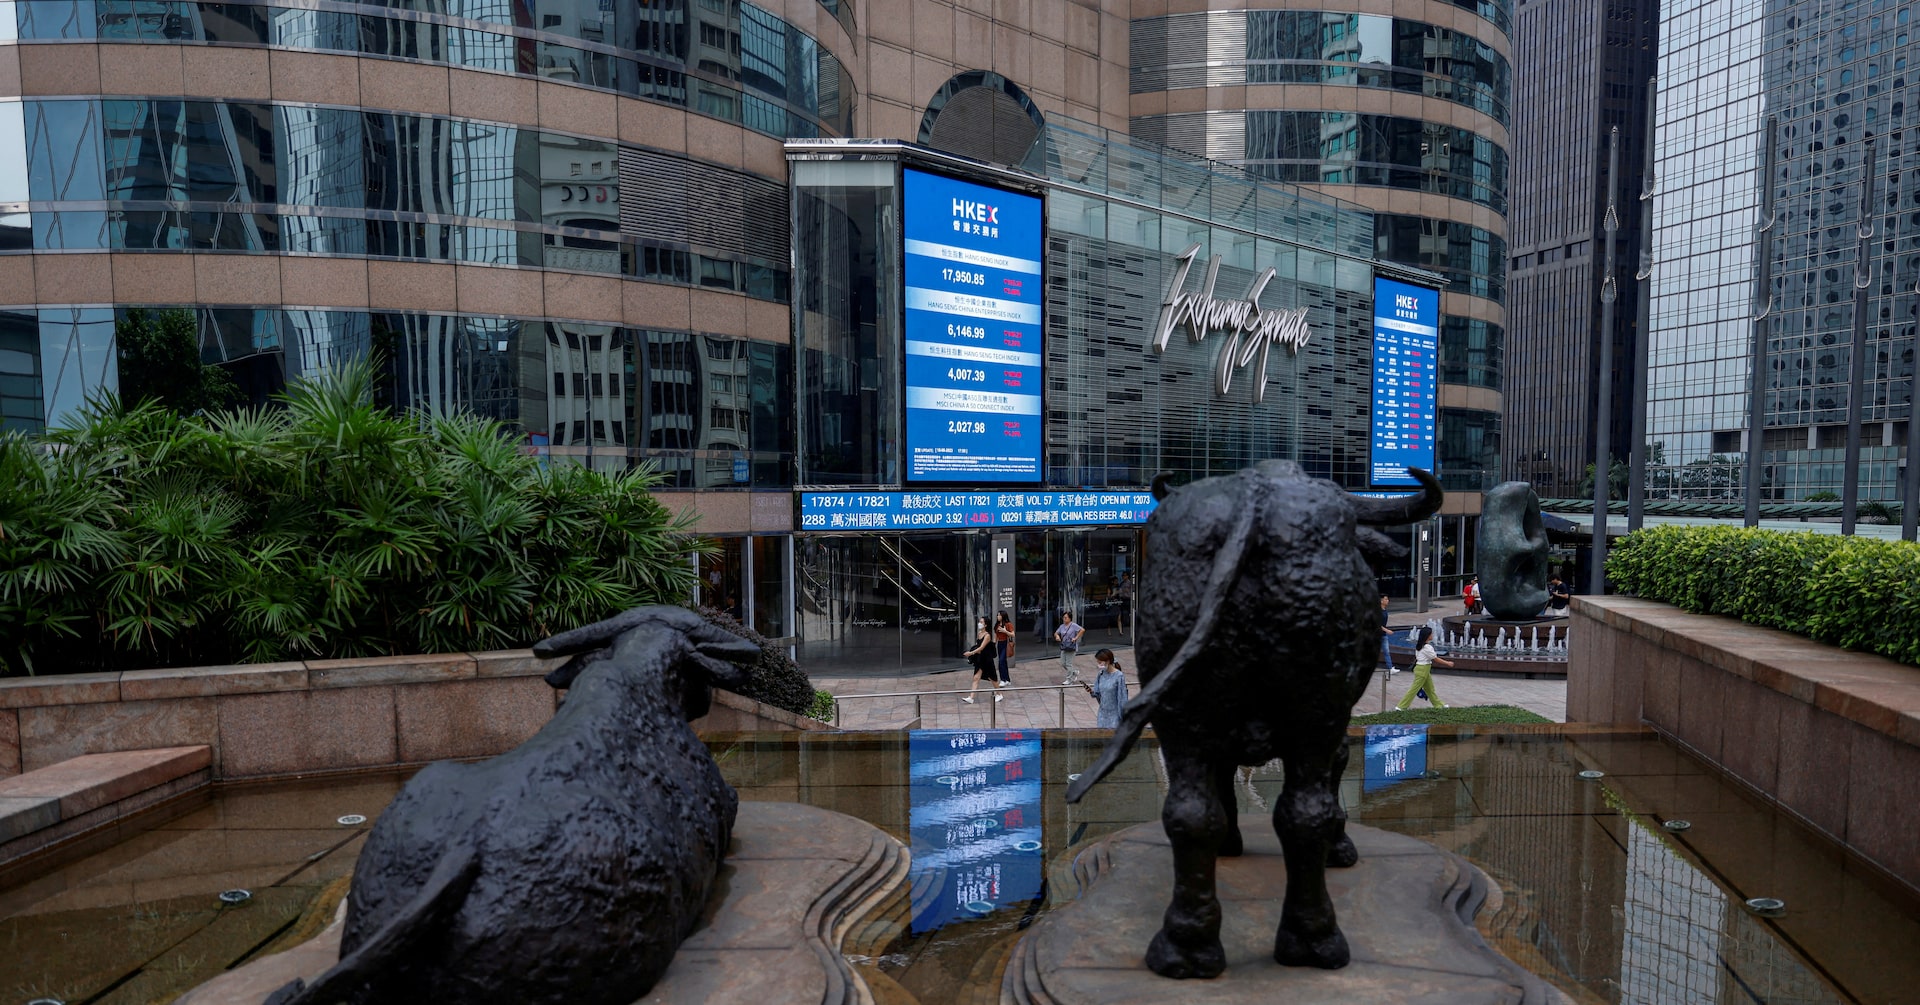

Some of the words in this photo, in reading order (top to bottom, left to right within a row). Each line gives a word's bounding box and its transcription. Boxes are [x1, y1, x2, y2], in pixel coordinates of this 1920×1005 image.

[952, 198, 998, 224] HKEX
[953, 220, 998, 238] 香港交易所
[964, 252, 980, 261] HANG
[980, 254, 992, 264] SENG
[994, 256, 1008, 266] INDEX
[942, 268, 985, 286] 17,950.85
[1396, 294, 1418, 310] HKEX
[928, 300, 943, 309] HANG
[944, 302, 958, 311] SENG
[958, 304, 974, 313] CHINA
[975, 306, 1006, 318] ENTERPRISES
[1007, 312, 1022, 320] INDEX
[1152, 242, 1261, 396] Exchange
[1236, 266, 1312, 404] Square
[947, 324, 985, 339] 6,146.99
[964, 348, 978, 358] HANG
[979, 350, 992, 359] SENG
[993, 352, 1005, 360] TECH
[1006, 353, 1020, 362] INDEX
[948, 368, 985, 382] 4,007.39
[948, 421, 985, 434] 2,027.98
[811, 496, 844, 507] 17874
[848, 496, 853, 507] /
[858, 496, 890, 507] 17821
[902, 494, 942, 509] 最後成交
[944, 496, 965, 506] LAST
[969, 496, 990, 506] 17821
[997, 494, 1024, 508] 成交額
[1026, 495, 1041, 506] VOL
[1043, 495, 1052, 505] 57
[1058, 494, 1097, 507] 未平倉合約
[1100, 495, 1119, 505] OPEN
[1119, 495, 1130, 505] INT
[1133, 495, 1151, 505] 12073
[830, 513, 886, 527] 萬洲國際
[892, 514, 910, 525] WH
[911, 514, 942, 525] GROUP
[946, 513, 962, 524] 3.92
[1001, 512, 1022, 522] 00291
[1025, 510, 1059, 523] 華潤啤酒
[1061, 511, 1083, 521] CHINA
[1083, 511, 1098, 520] RES
[1099, 510, 1117, 520] BEER
[1119, 510, 1132, 520] 46.0
[997, 548, 1007, 563] H
